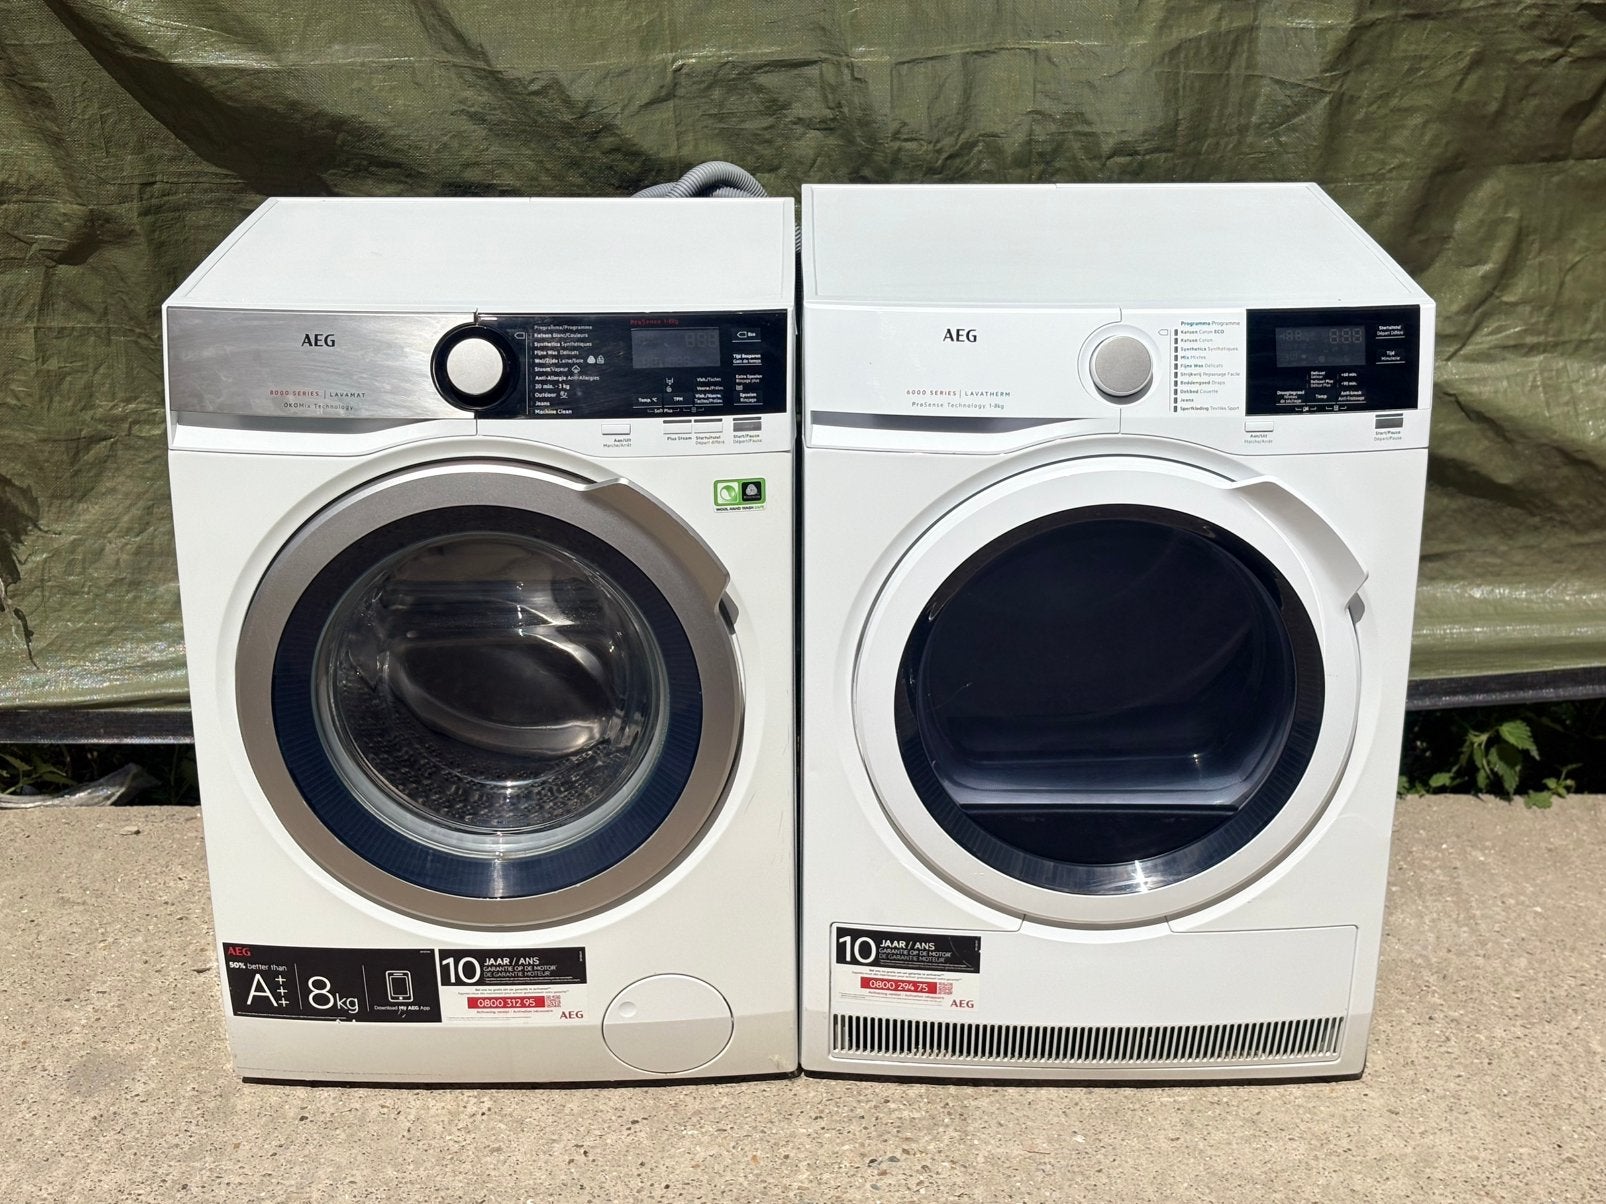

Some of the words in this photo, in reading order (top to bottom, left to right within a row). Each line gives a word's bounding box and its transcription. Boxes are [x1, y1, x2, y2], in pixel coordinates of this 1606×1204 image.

[301, 333, 335, 347] AEG
[943, 328, 977, 342] AEG
[314, 403, 354, 411] Technology
[947, 402, 985, 410] Technology
[838, 935, 876, 963] 10
[880, 940, 906, 948] JAAR
[908, 941, 912, 949] /
[914, 941, 935, 950] ANS
[227, 947, 251, 956] AEG
[229, 961, 246, 969] 50%
[271, 964, 287, 972] than
[484, 957, 510, 966] JAAR
[512, 957, 516, 965] /
[518, 957, 539, 965] ANS
[442, 957, 481, 984] 10
[870, 979, 894, 989] 0800
[898, 981, 914, 991] 294
[917, 982, 928, 992] 75
[477, 999, 503, 1007] 0800
[506, 999, 521, 1007] 312
[523, 999, 535, 1007] 95
[950, 999, 974, 1009] AEG
[559, 1010, 584, 1020] AEG
